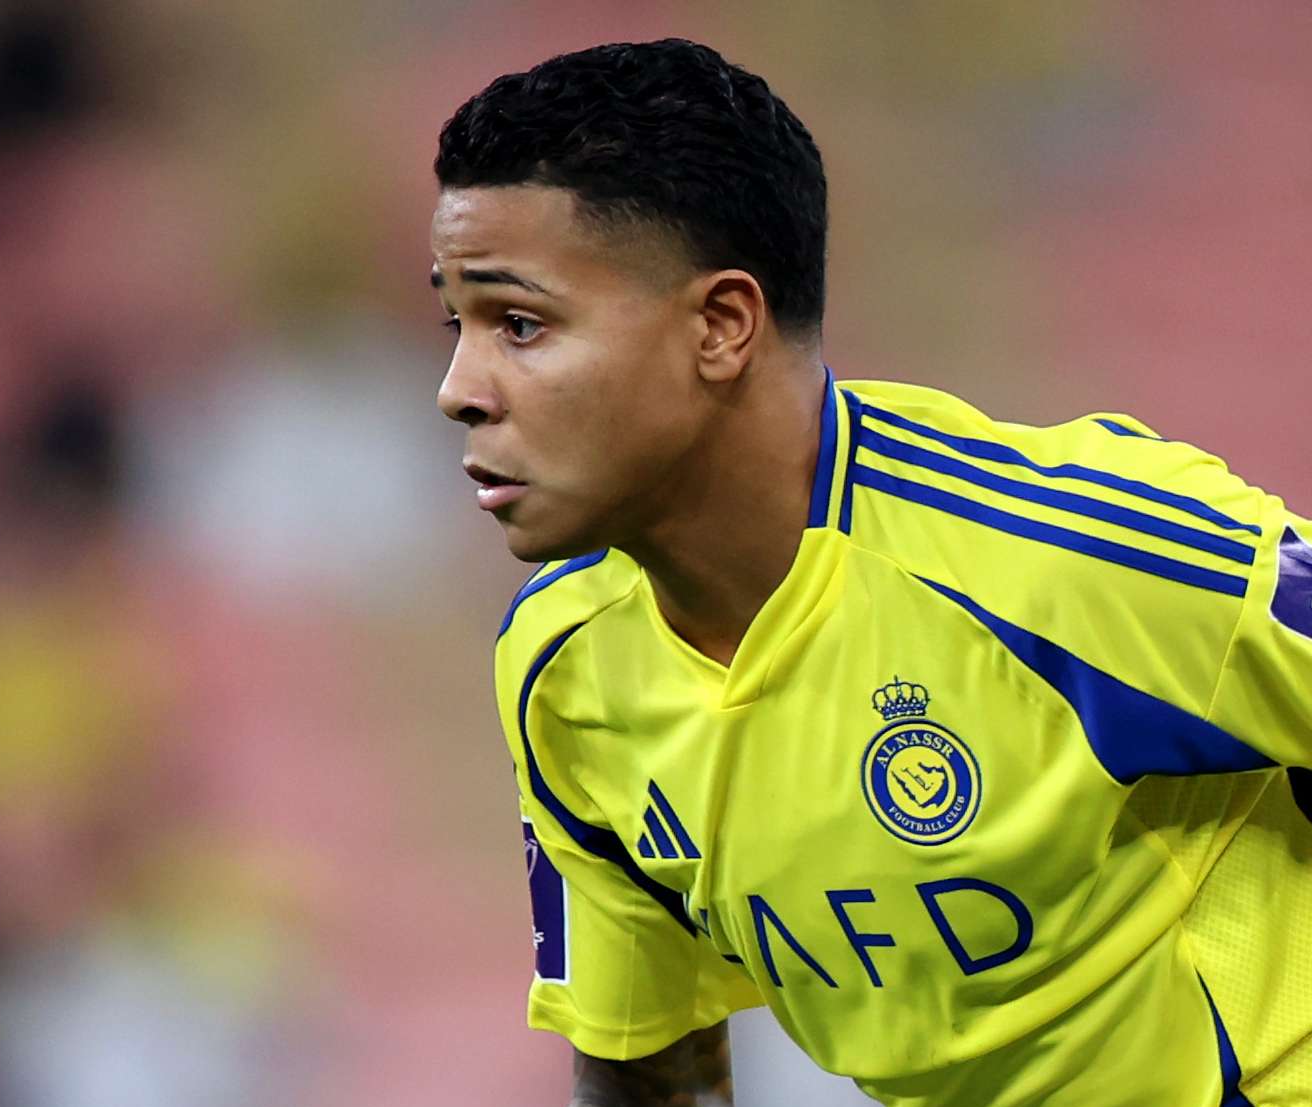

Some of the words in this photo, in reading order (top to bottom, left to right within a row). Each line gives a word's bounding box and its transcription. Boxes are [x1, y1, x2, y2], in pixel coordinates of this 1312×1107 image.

[894, 732, 954, 759] NASSR
[889, 806, 946, 832] FOOTBALL
[945, 795, 965, 823] CLUB
[698, 877, 1034, 988] AFD
